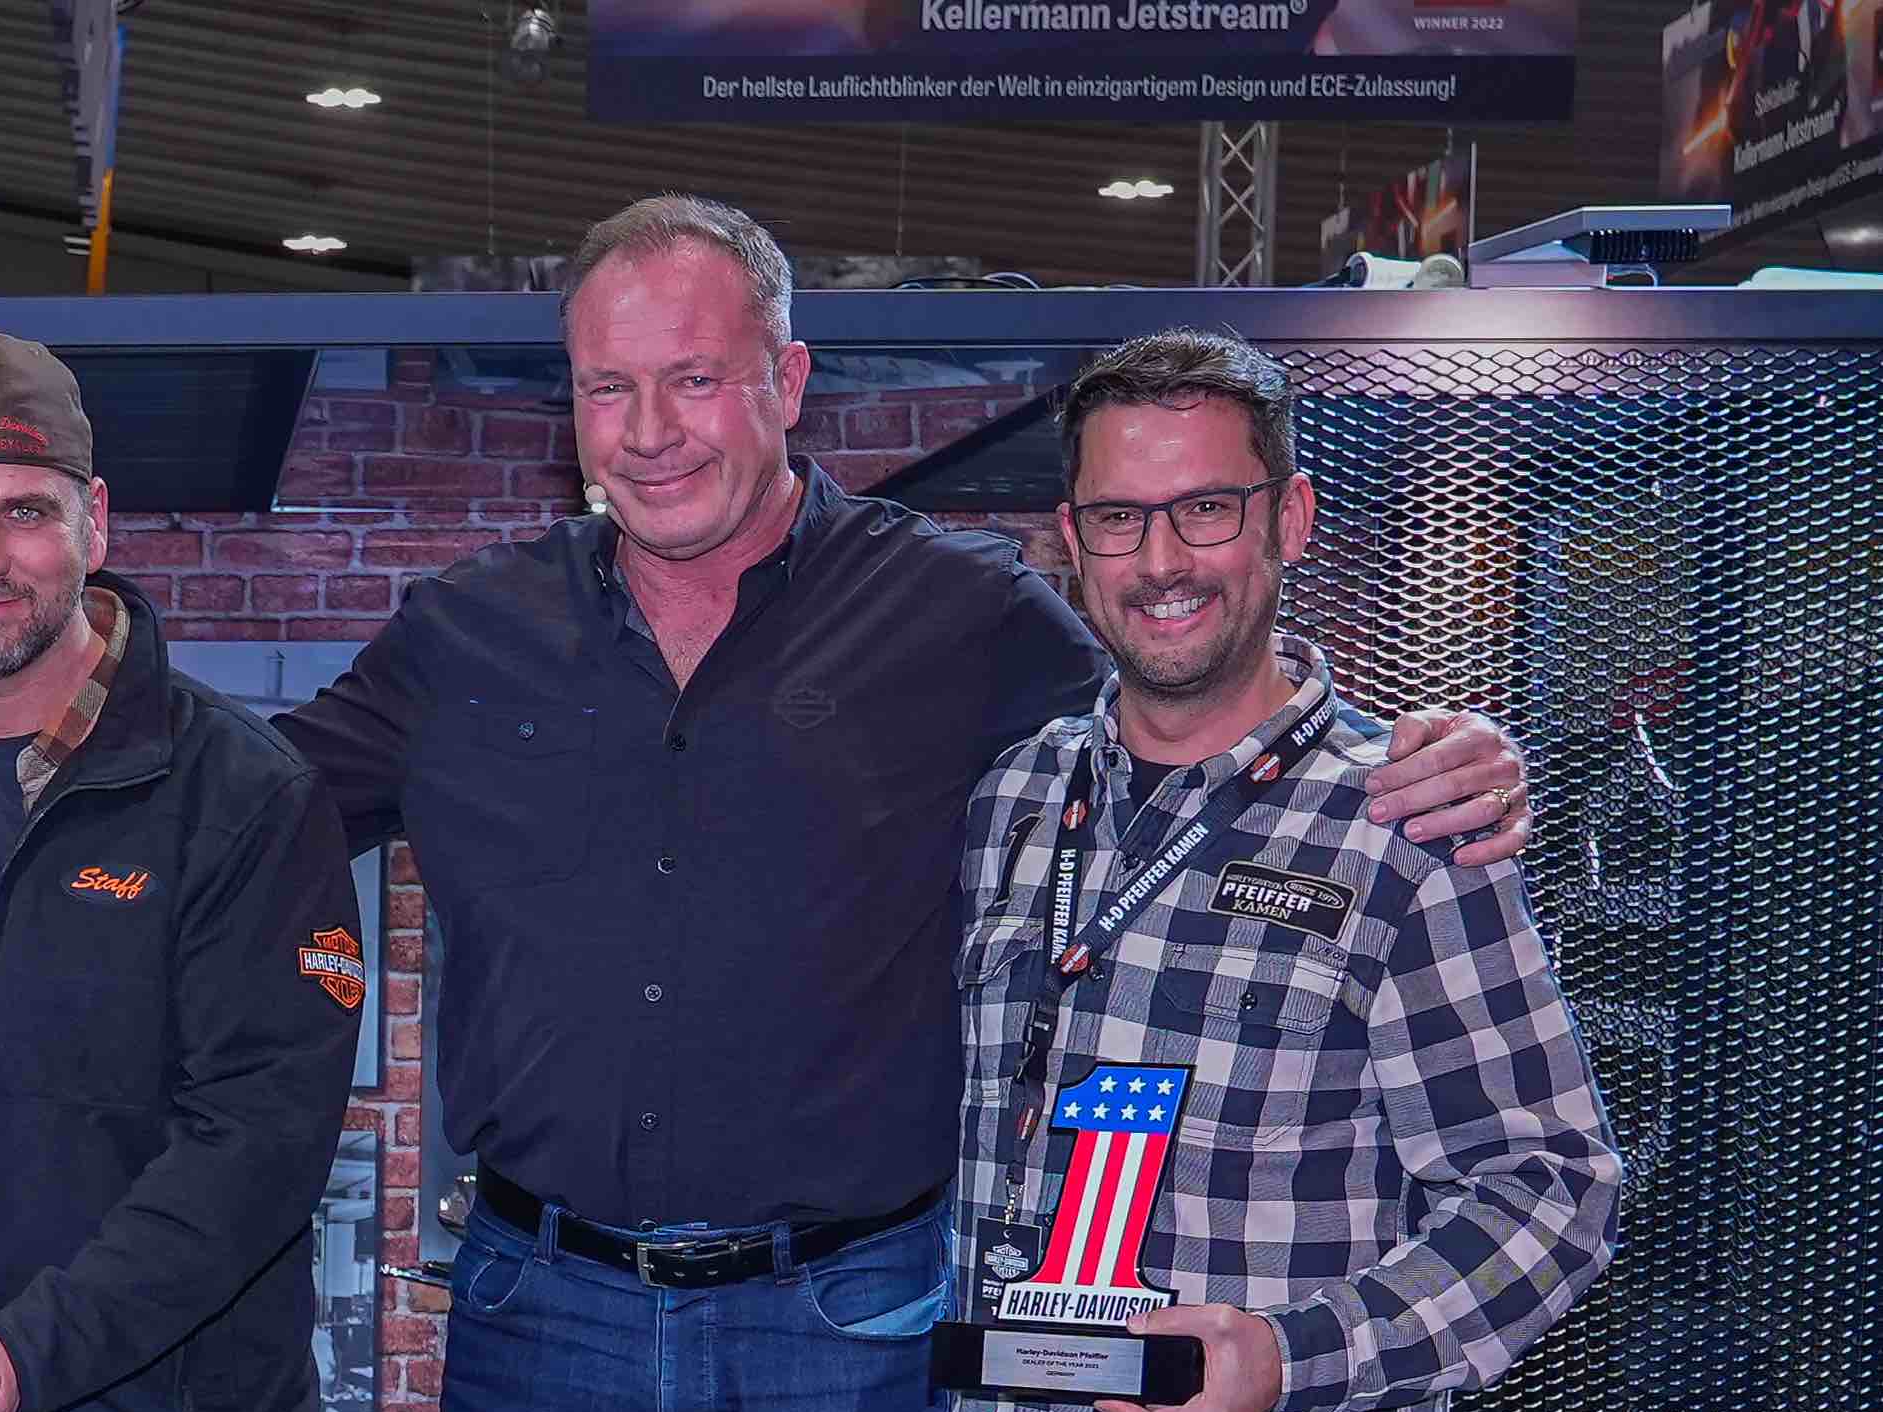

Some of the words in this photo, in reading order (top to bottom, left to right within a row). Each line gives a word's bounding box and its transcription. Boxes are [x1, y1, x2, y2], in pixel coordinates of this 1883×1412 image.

[921, 0, 1111, 31] Kellermann
[1414, 16, 1468, 30] WINNER
[1472, 16, 1504, 30] 2022
[703, 75, 738, 98] Der
[742, 75, 805, 98] hellste
[809, 75, 957, 98] Lauflichtblinker
[960, 75, 994, 98] der
[997, 75, 1041, 98] Welt
[1044, 75, 1063, 98] in
[1066, 75, 1197, 101] einzigartigem
[1201, 74, 1267, 101] Design
[1270, 75, 1307, 98] und
[1311, 75, 1455, 101] ECE-Zulassung!
[1290, 722, 1315, 746] H-D
[1059, 849, 1077, 871] H-D
[69, 866, 151, 900] Staff
[1099, 906, 1124, 932] H-D
[1118, 859, 1172, 911] PFEIFFER
[1164, 821, 1209, 865] KAMEN
[1053, 872, 1074, 928] PFEIFFER
[1221, 882, 1313, 913] PFEIFFER
[1231, 898, 1293, 920] KAMEN
